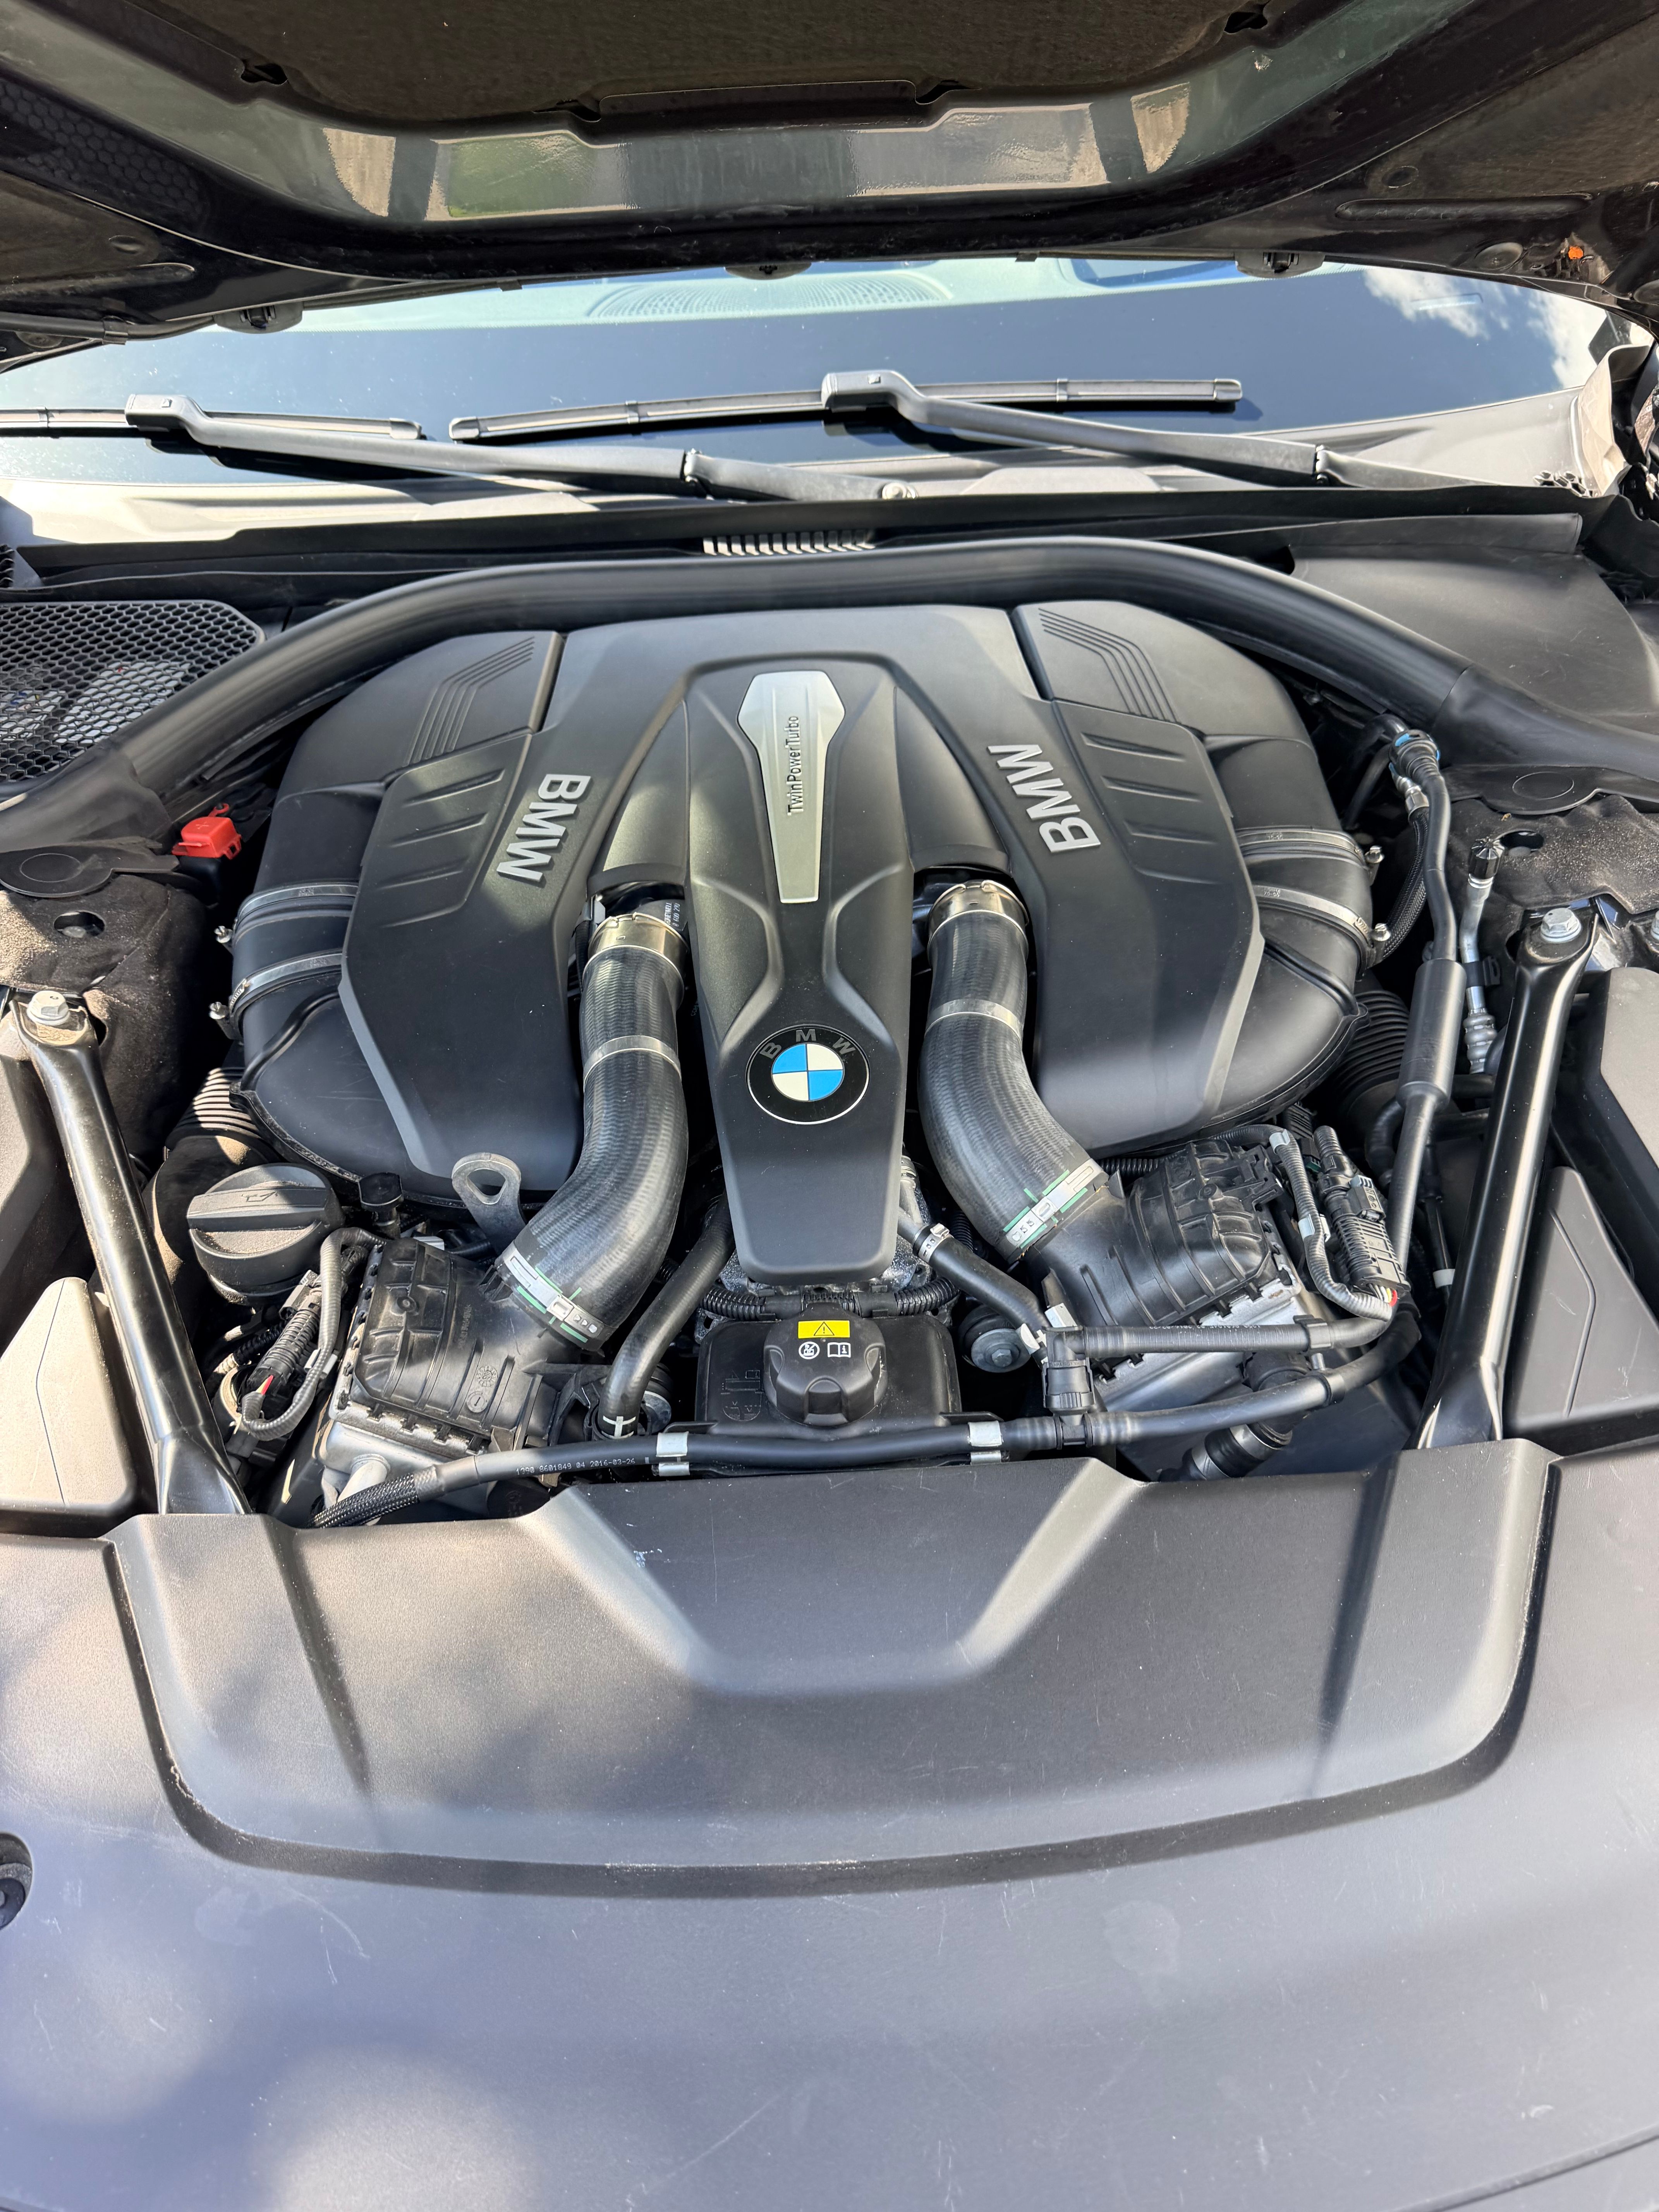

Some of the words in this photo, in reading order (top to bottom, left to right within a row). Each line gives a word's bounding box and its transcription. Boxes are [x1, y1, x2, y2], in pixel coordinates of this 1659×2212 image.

[496, 773, 591, 882] BMW
[987, 744, 1101, 854] BMW
[759, 1029, 856, 1059] BMW
[539, 1463, 572, 1472] 8601849
[590, 1458, 635, 1467] 2016-03-26
